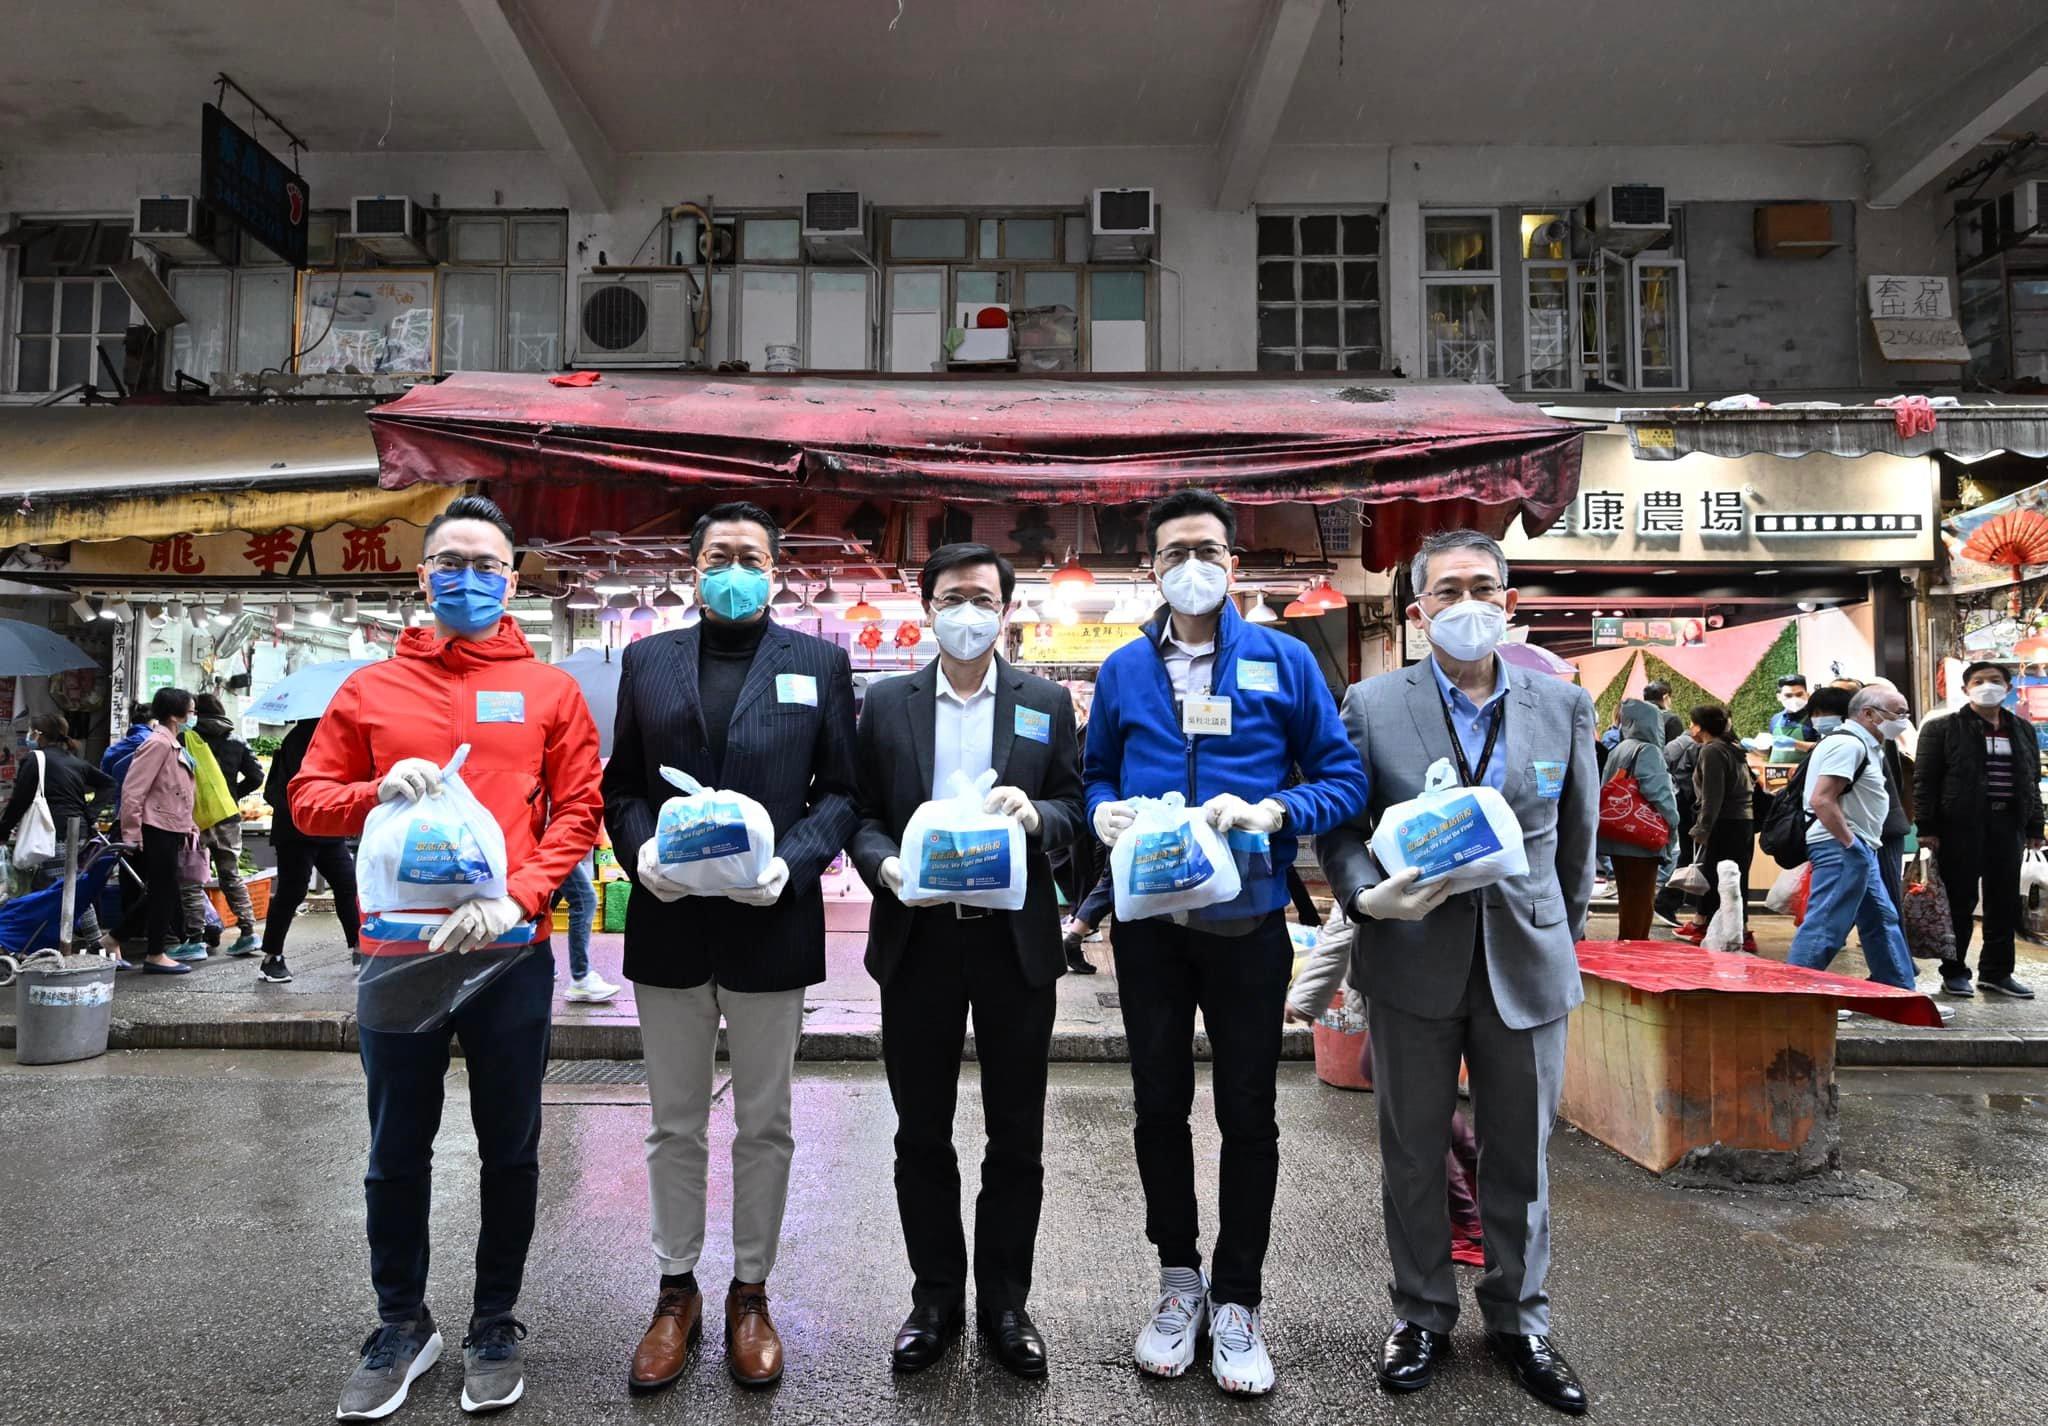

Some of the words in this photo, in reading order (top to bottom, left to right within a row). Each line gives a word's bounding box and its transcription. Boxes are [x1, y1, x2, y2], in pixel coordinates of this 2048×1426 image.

[1880, 298, 1943, 317] 出租
[1548, 490, 1744, 531] 康農場
